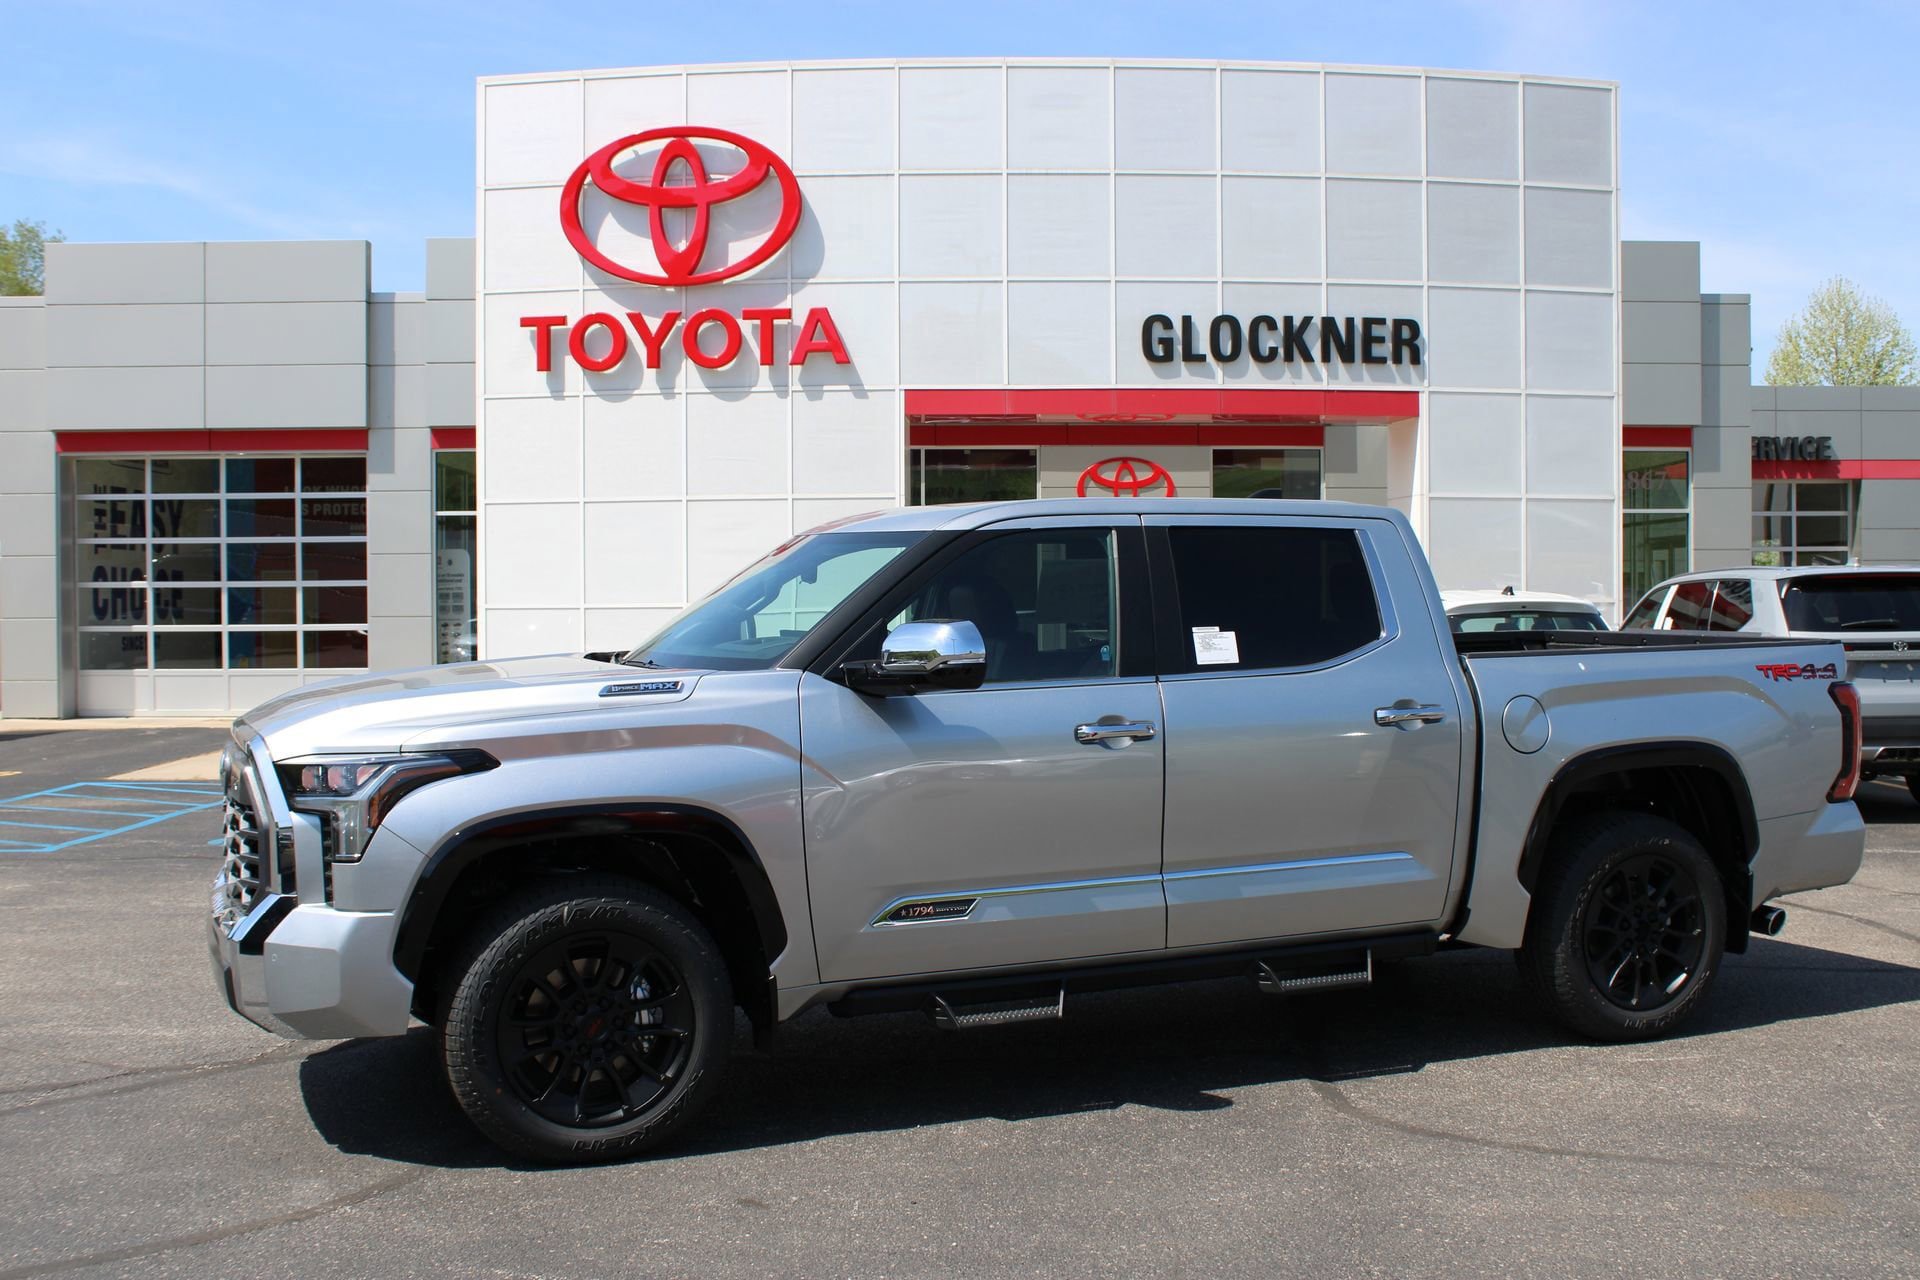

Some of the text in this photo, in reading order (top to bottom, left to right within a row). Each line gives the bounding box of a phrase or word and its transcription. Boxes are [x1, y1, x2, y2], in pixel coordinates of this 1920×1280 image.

[520, 307, 850, 372] TOYOTA
[1142, 314, 1422, 366] GLOCKNER
[93, 483, 107, 554] THE
[110, 485, 184, 555] EASY
[93, 565, 184, 622] CHOCE
[640, 683, 675, 691] MAX
[1756, 664, 1802, 681] TRD
[909, 905, 935, 917] 1794
